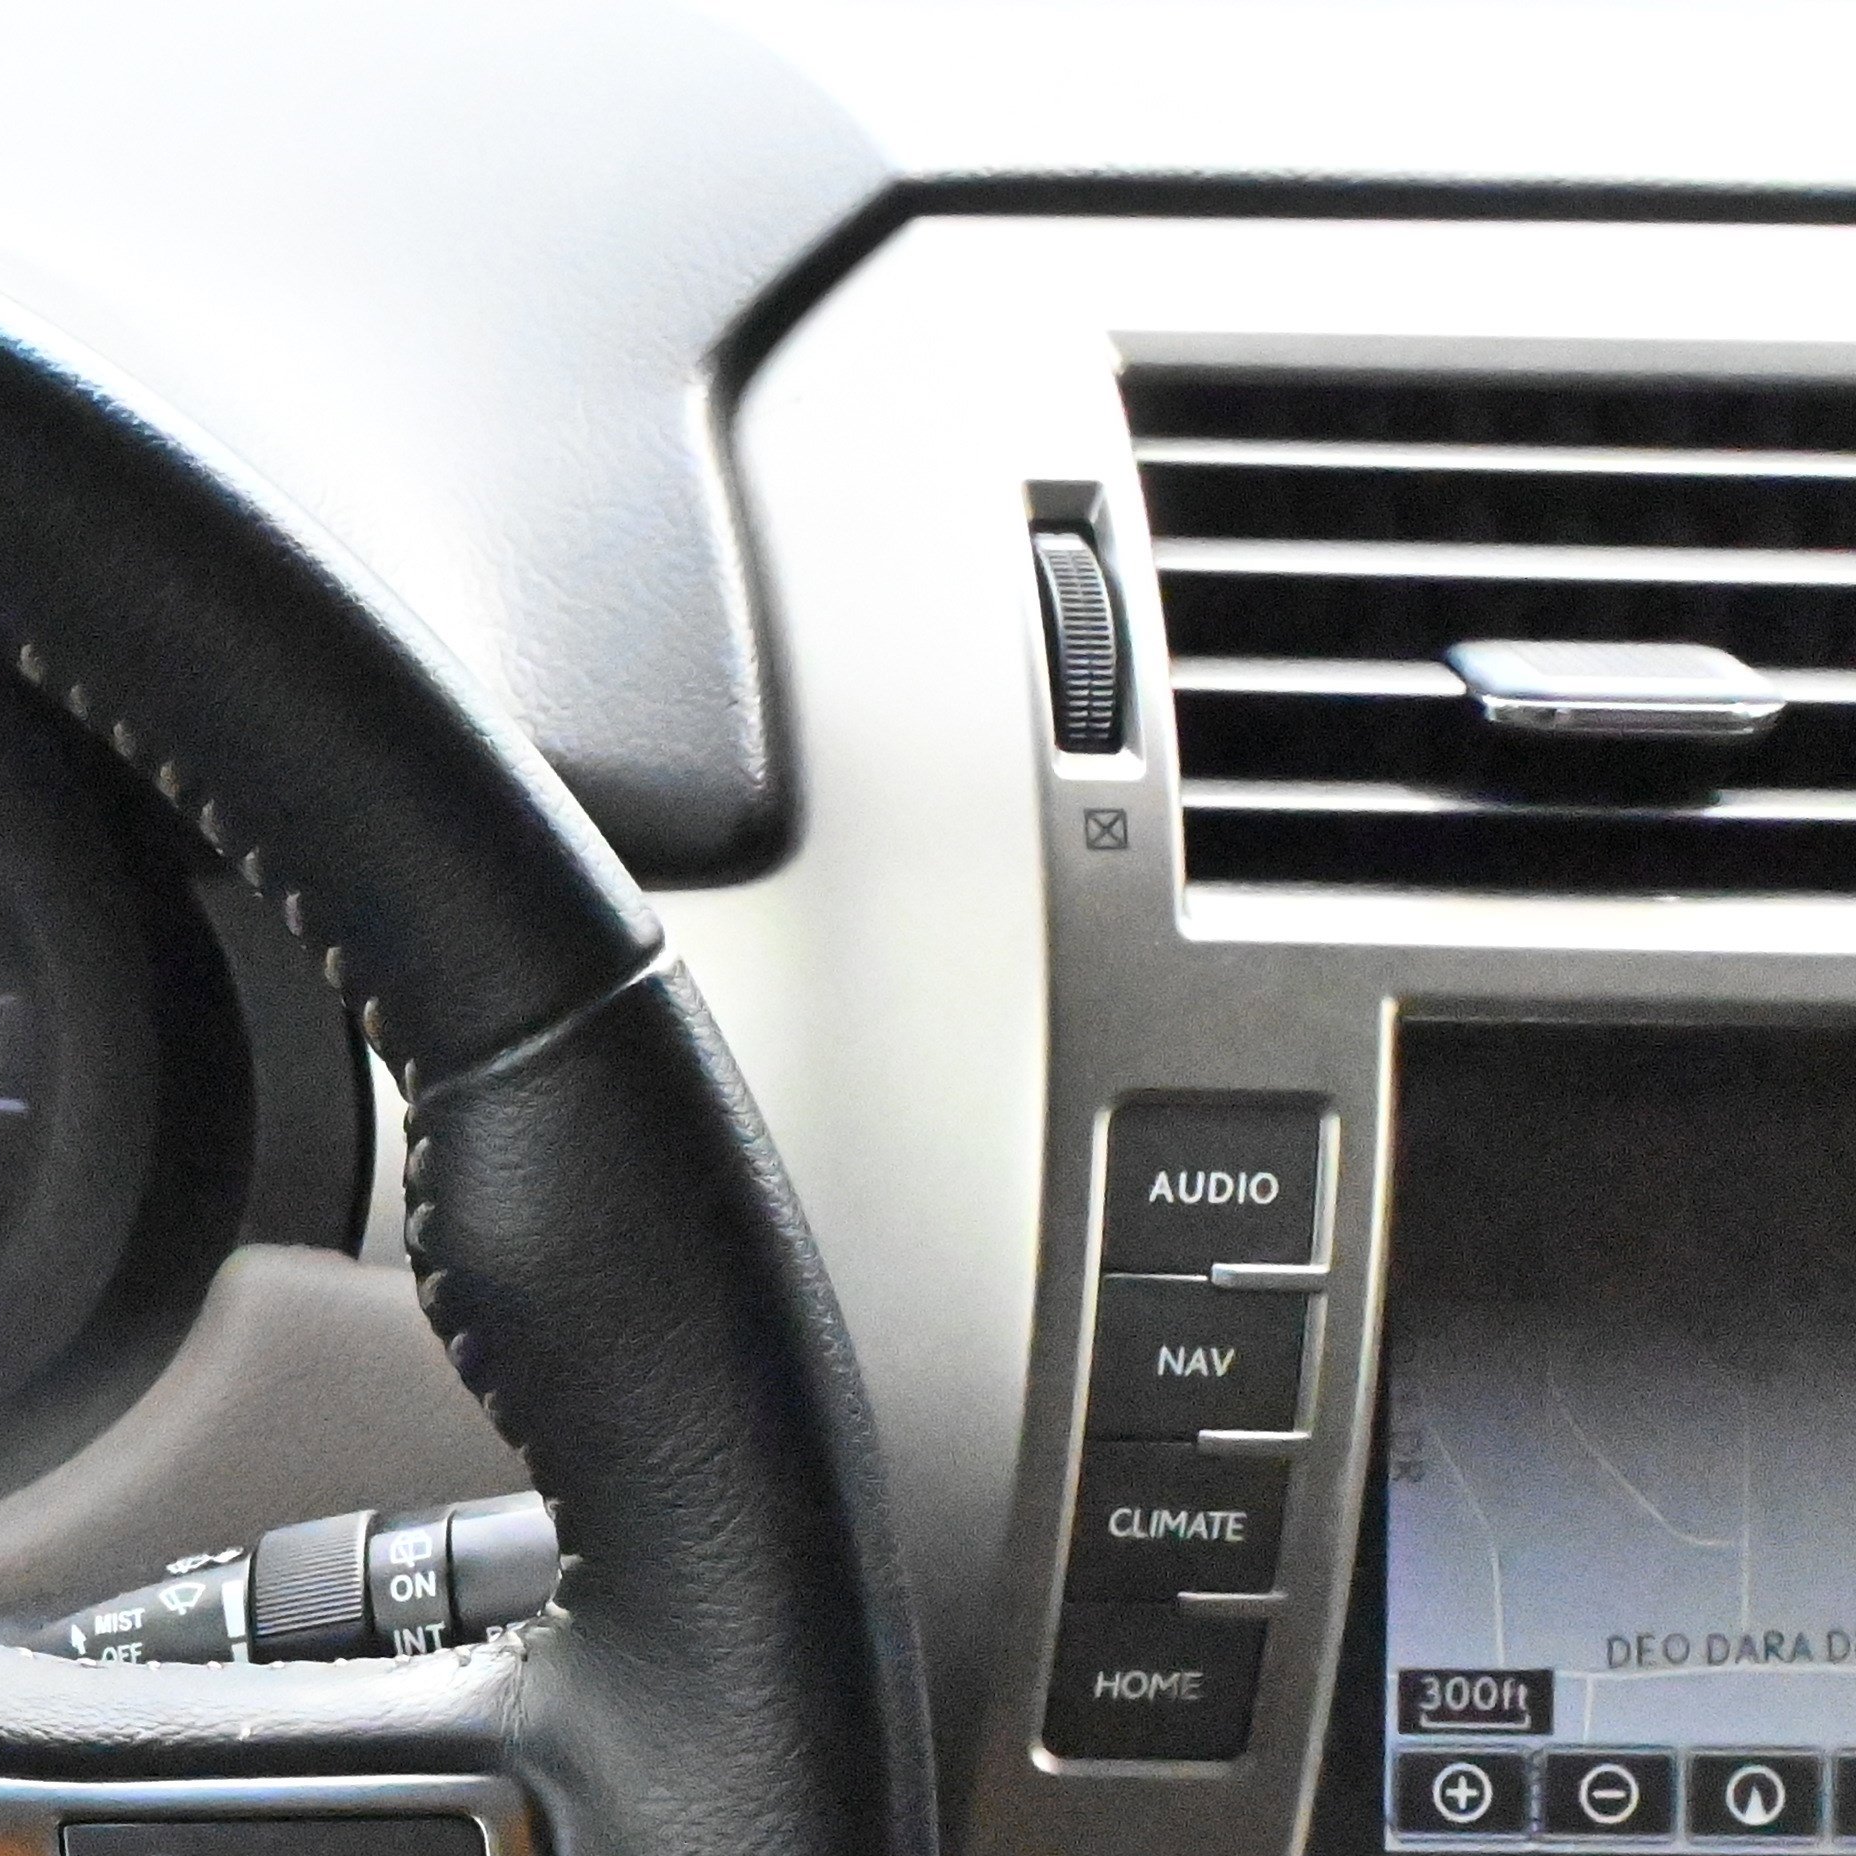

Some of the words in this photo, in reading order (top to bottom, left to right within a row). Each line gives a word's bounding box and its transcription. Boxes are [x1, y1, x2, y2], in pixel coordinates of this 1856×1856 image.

[1150, 1171, 1280, 1205] AUDIO
[1158, 1347, 1238, 1378] NAV
[1109, 1507, 1248, 1541] CLIMATE
[390, 1571, 436, 1602] ON
[95, 1607, 146, 1636] MIST
[393, 1621, 446, 1655] INT
[1706, 1629, 1814, 1666] DARA
[1095, 1670, 1203, 1700] HOME
[1419, 1675, 1528, 1711] 300ft
